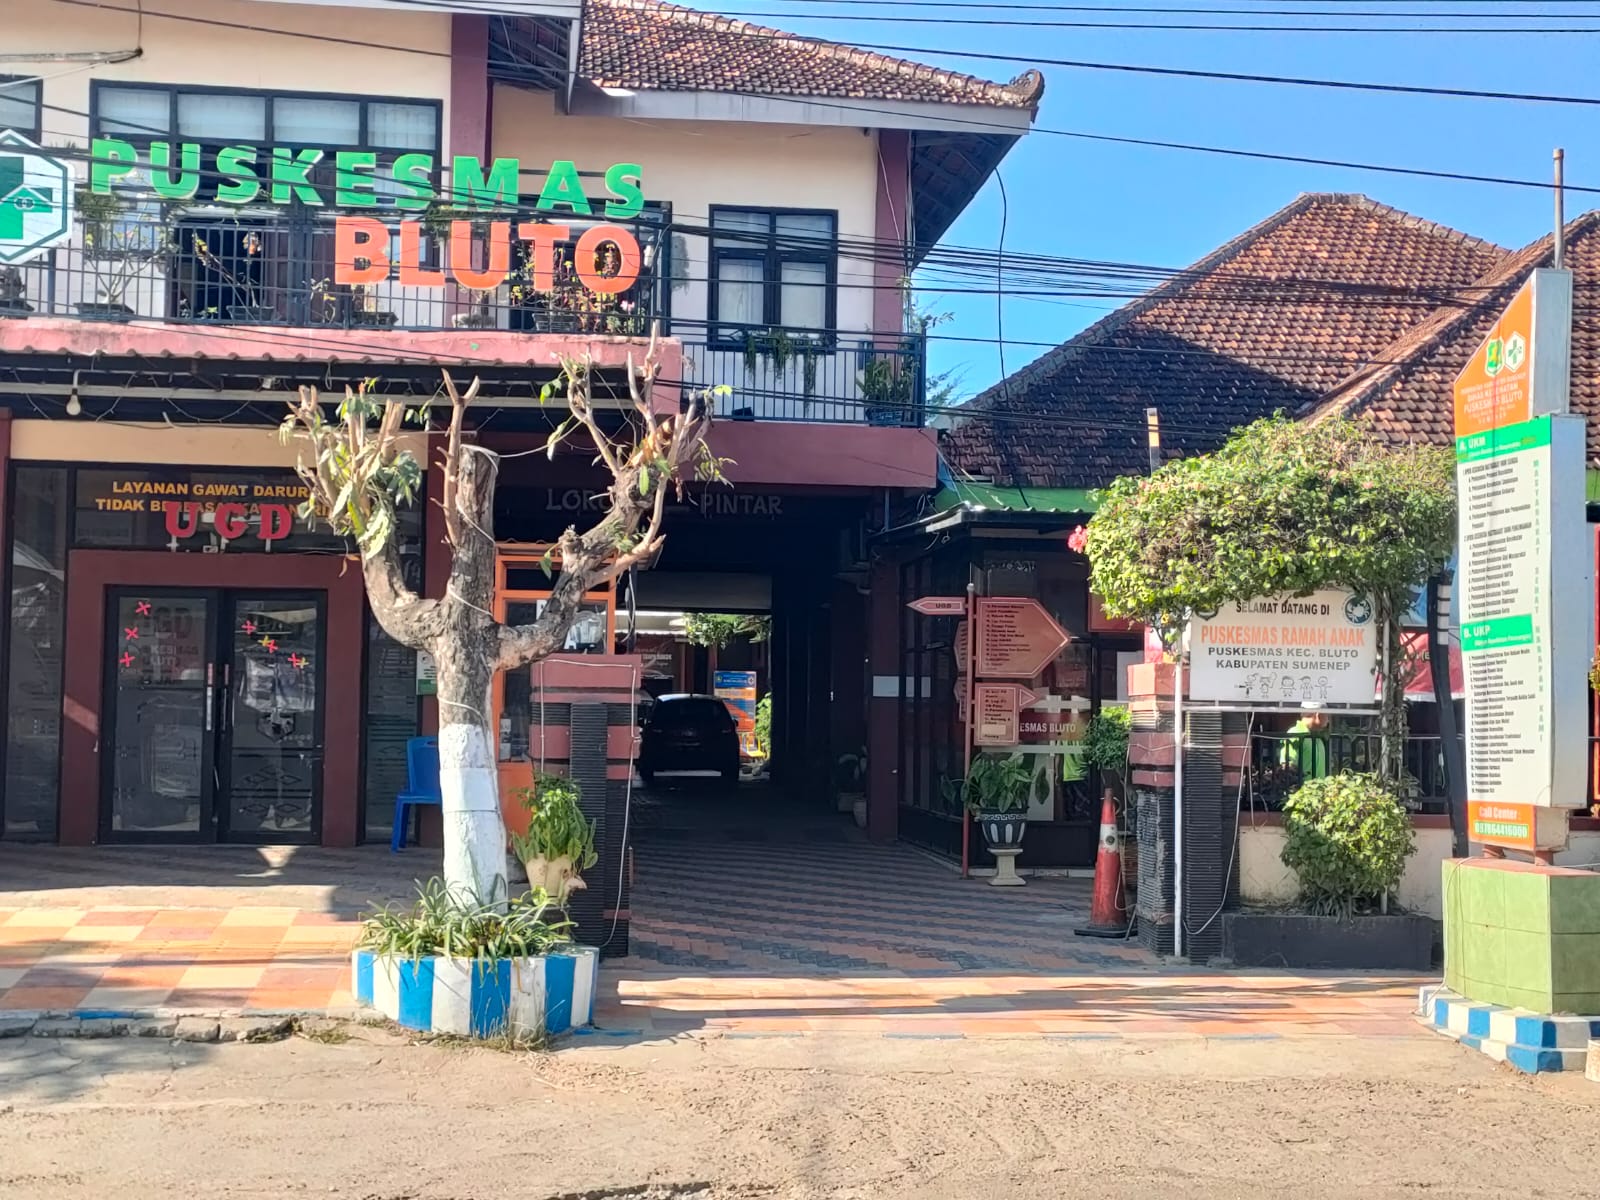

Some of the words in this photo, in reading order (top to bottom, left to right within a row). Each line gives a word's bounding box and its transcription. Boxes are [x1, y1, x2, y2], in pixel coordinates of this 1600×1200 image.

[90, 137, 644, 218] PUSKESMAS
[334, 216, 642, 293] BLUTO
[1501, 390, 1523, 404] BLUTO
[113, 481, 188, 495] LAYANAN
[193, 484, 249, 496] GAWAT
[253, 485, 309, 498] DARUR
[95, 498, 144, 511] TIDAK
[700, 494, 782, 515] PINTAR
[164, 501, 293, 540] UGD
[1236, 601, 1279, 614] SELAMAT
[1281, 602, 1318, 615] DATANG
[1320, 604, 1330, 615] DI
[1201, 625, 1278, 645] PUSKESMAS
[1281, 626, 1326, 646] RAMAH
[1329, 628, 1365, 647] ANAK
[1473, 625, 1490, 638] UKP
[1208, 647, 1282, 657] PUSKESMAS
[1287, 648, 1314, 657] KEC.
[1319, 649, 1359, 658] BLUTO
[1216, 660, 1288, 669] KABUPATEN
[1292, 661, 1351, 671] SUMENEP
[1020, 722, 1047, 732] ESMAS
[1049, 723, 1076, 733] BLUTO
[1493, 807, 1518, 820] Center
